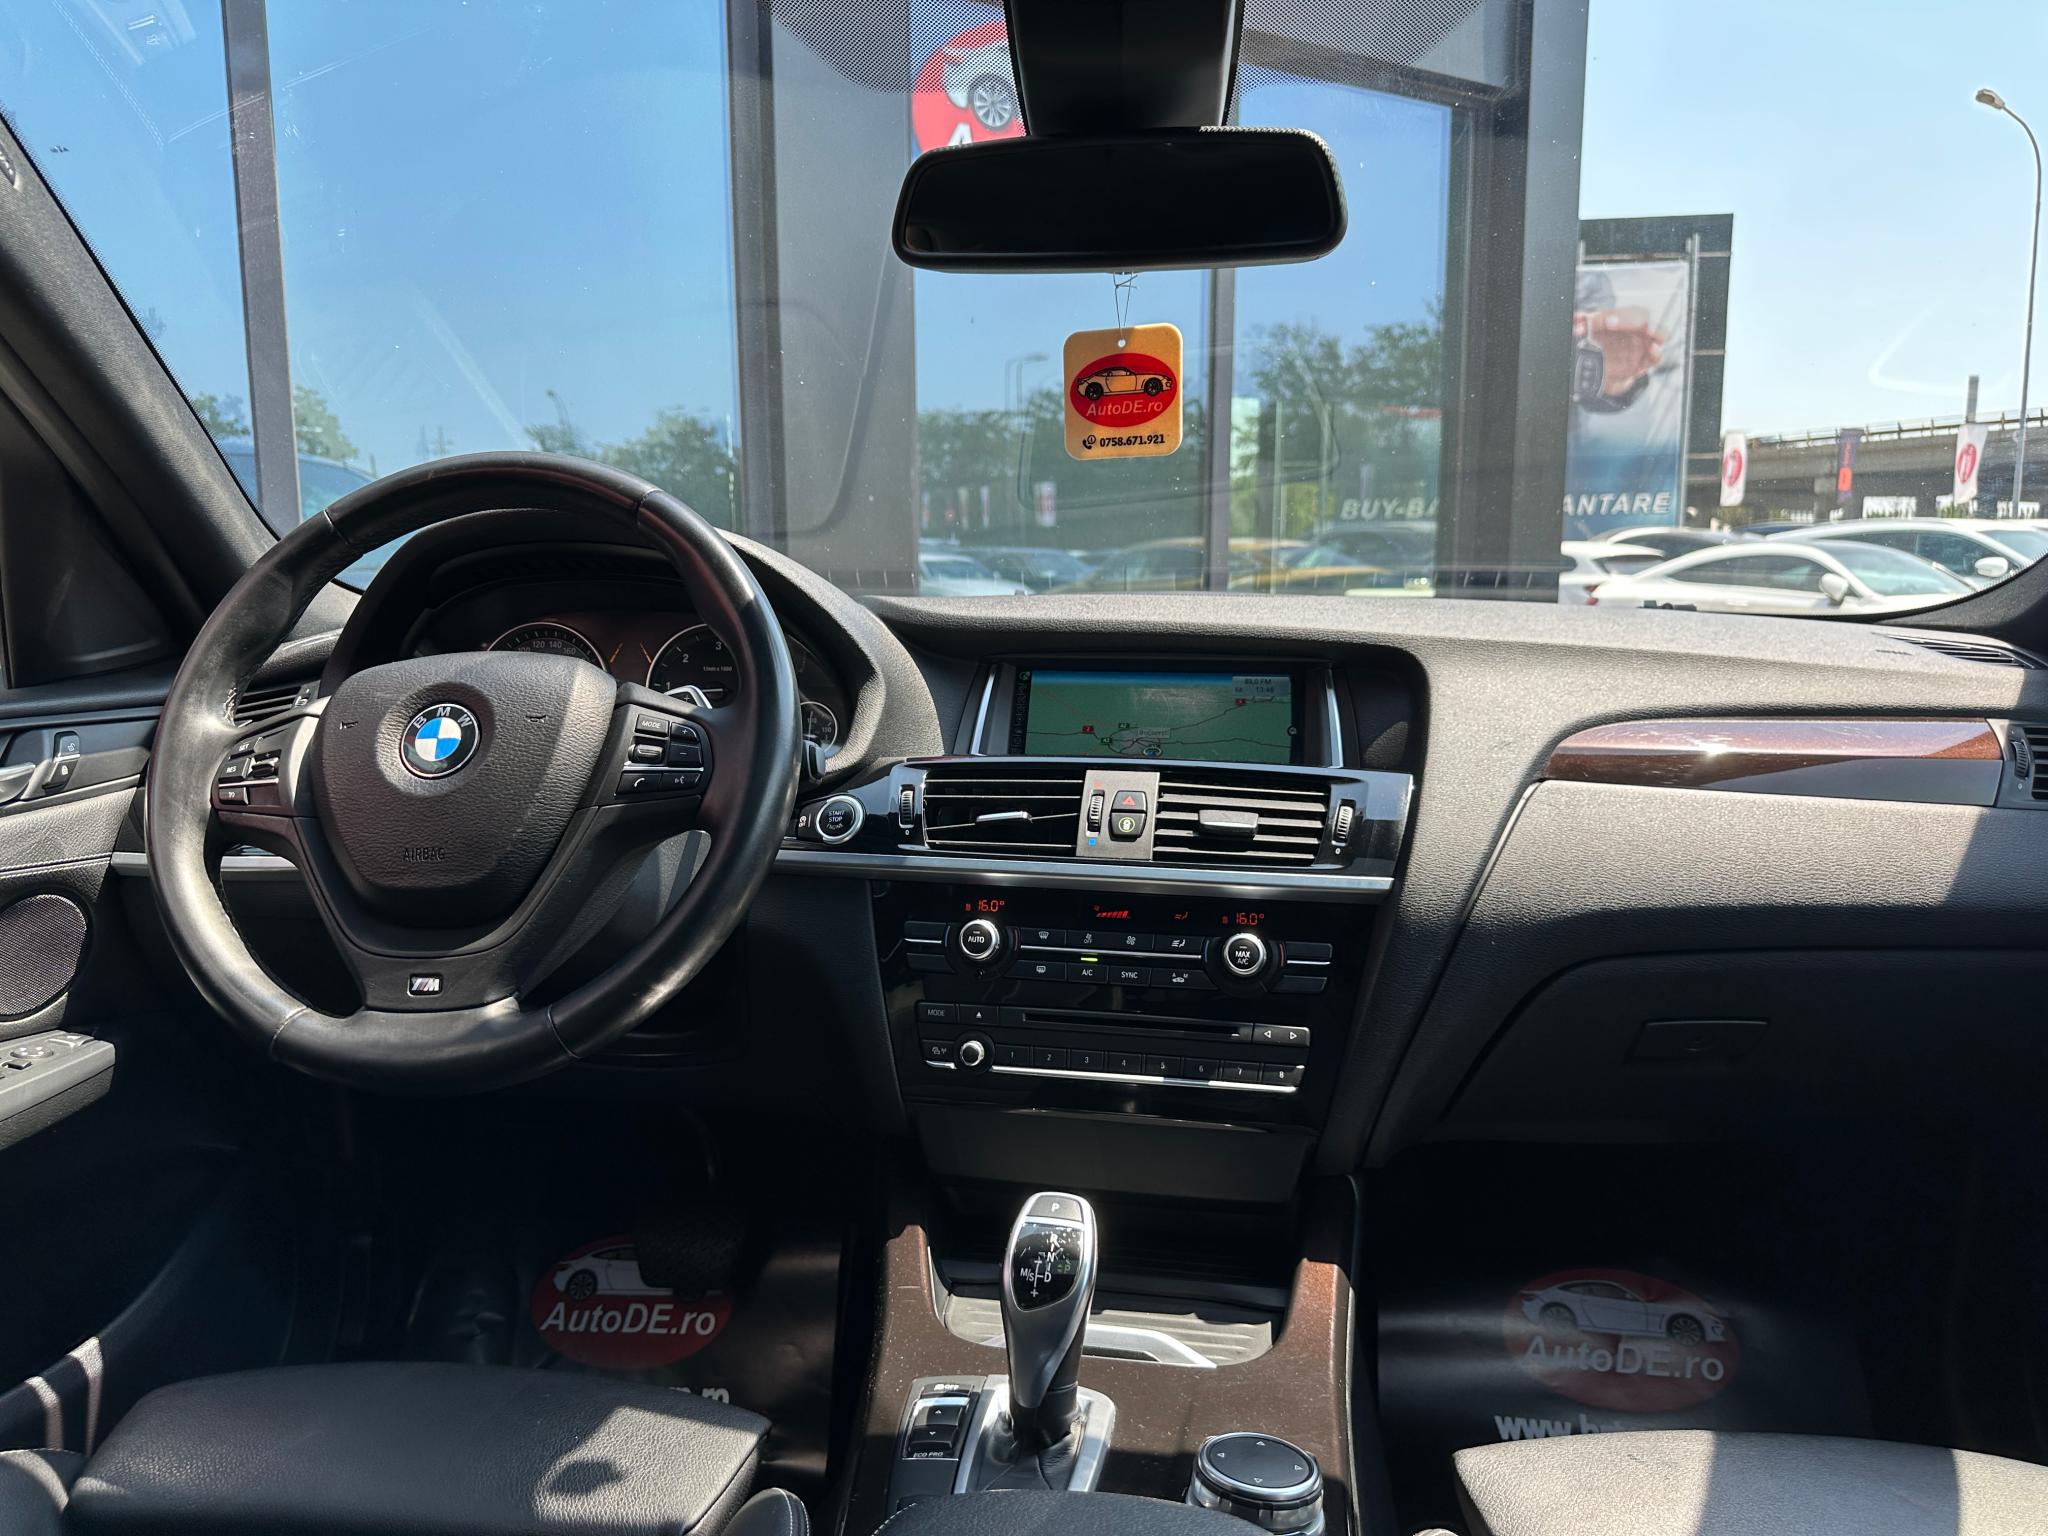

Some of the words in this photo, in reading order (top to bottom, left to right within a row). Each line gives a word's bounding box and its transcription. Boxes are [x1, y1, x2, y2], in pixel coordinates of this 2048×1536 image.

[1086, 400, 1163, 417] AutoDE.ro
[1099, 434, 1165, 447] 0758.671.921
[715, 641, 722, 651] 3
[682, 653, 689, 663] 2
[413, 706, 473, 729] BMW
[641, 720, 662, 729] MODE
[402, 848, 446, 862] AIRBAG
[967, 935, 985, 944] AUTO
[1235, 950, 1251, 959] MAX
[1081, 968, 1093, 976] A/C
[1121, 970, 1138, 980] SYNC
[927, 1008, 945, 1017] MODE
[1051, 1202, 1060, 1212] P
[1046, 1252, 1056, 1263] N
[1020, 1267, 1035, 1282] M/S
[1043, 1271, 1052, 1283] D
[539, 1301, 717, 1336] AutoDE.ro
[1522, 1334, 1725, 1382] AutoDE.ro
[912, 1451, 928, 1459] ECO
